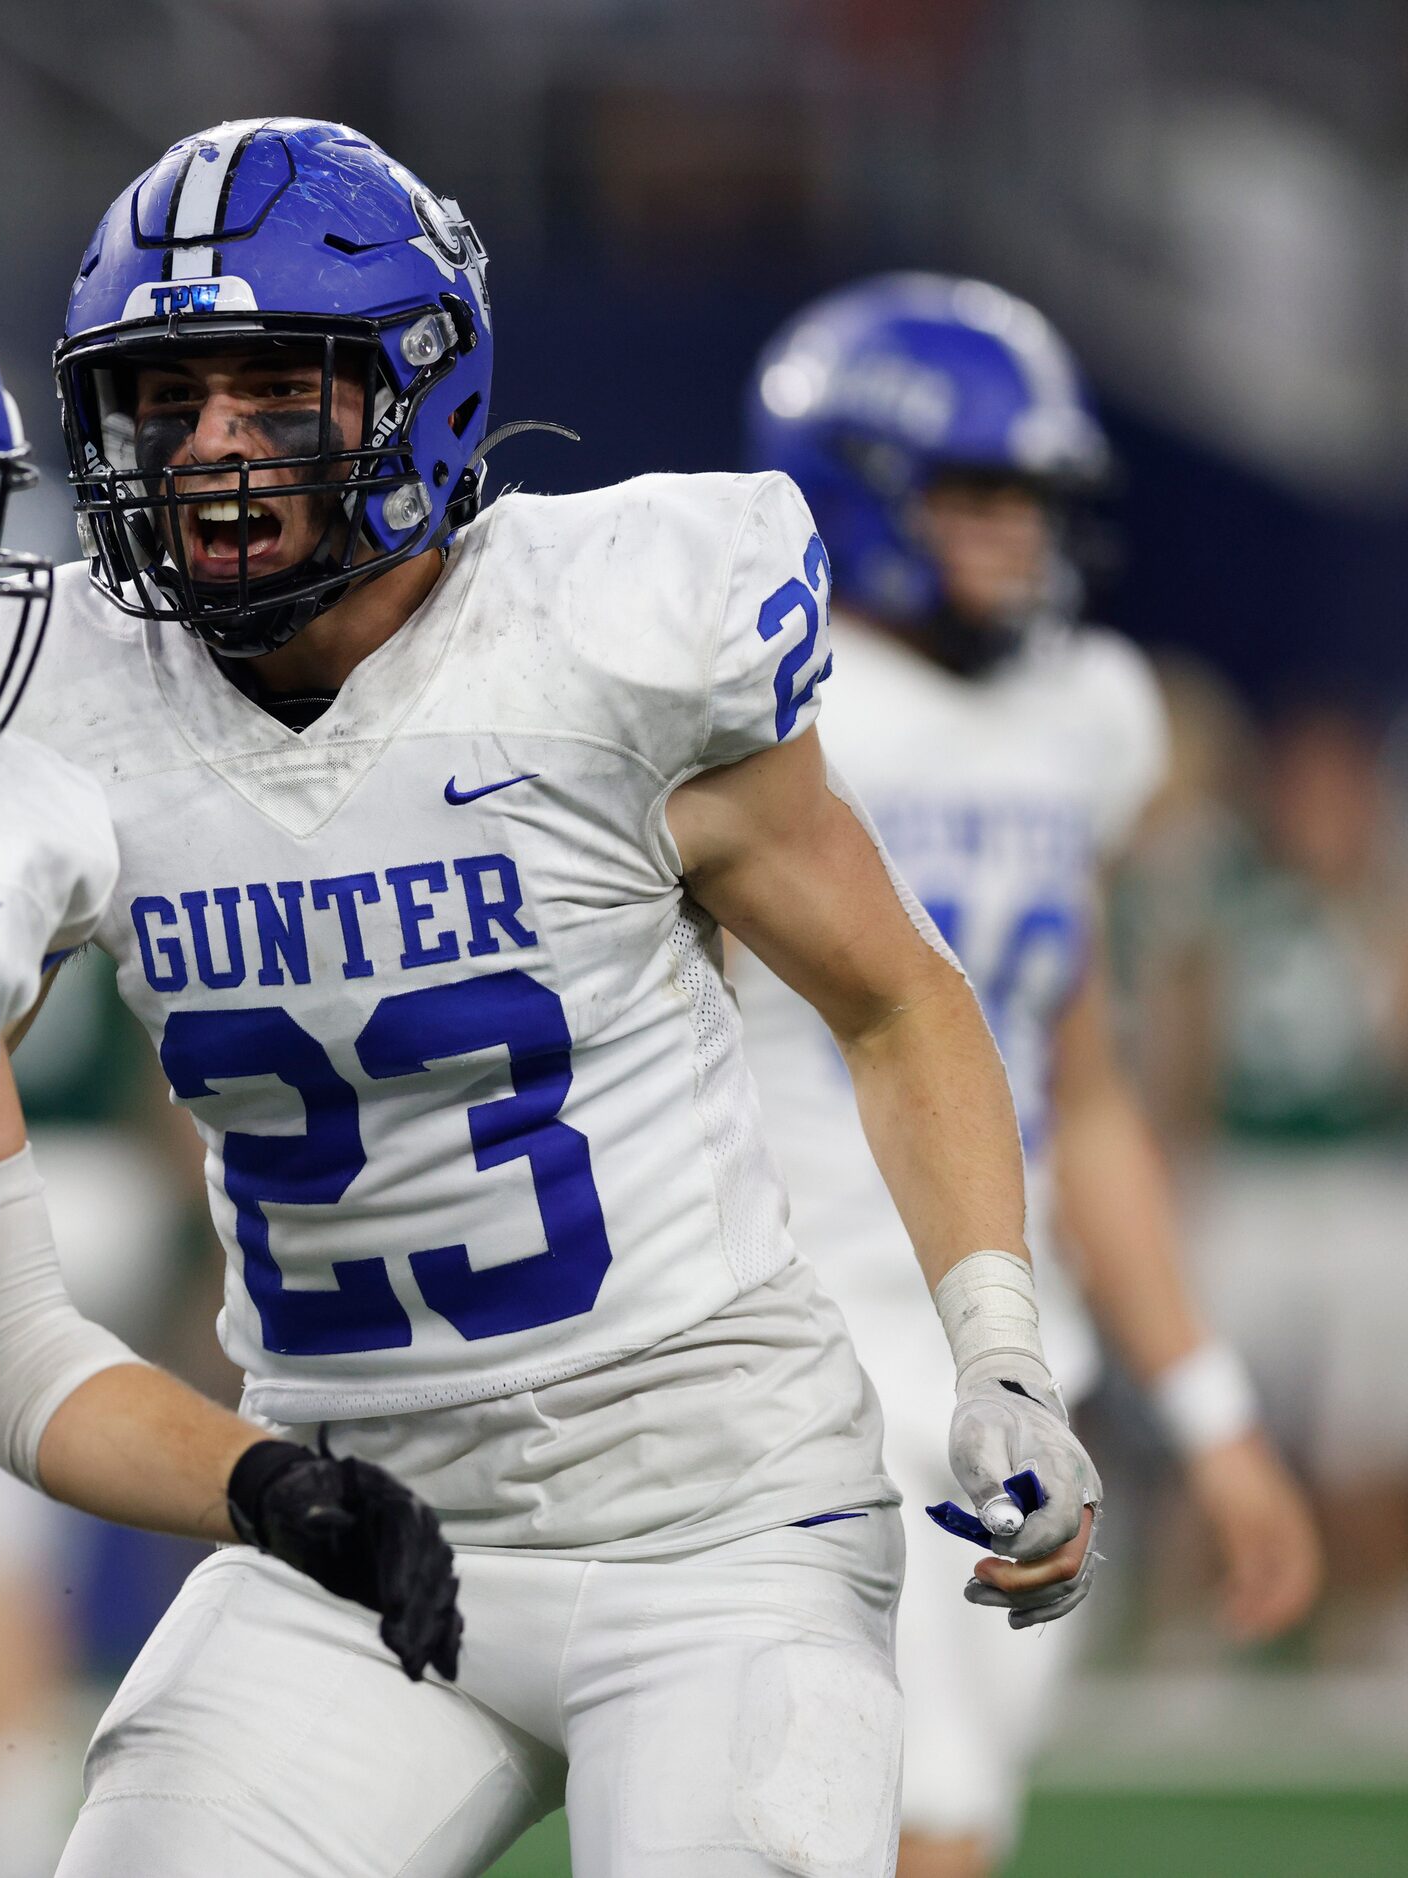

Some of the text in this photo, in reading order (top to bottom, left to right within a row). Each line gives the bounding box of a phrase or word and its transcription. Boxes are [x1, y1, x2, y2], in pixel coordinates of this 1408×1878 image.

[151, 283, 220, 317] TPW
[130, 852, 539, 993] GUNTER
[160, 968, 613, 1356] 23
